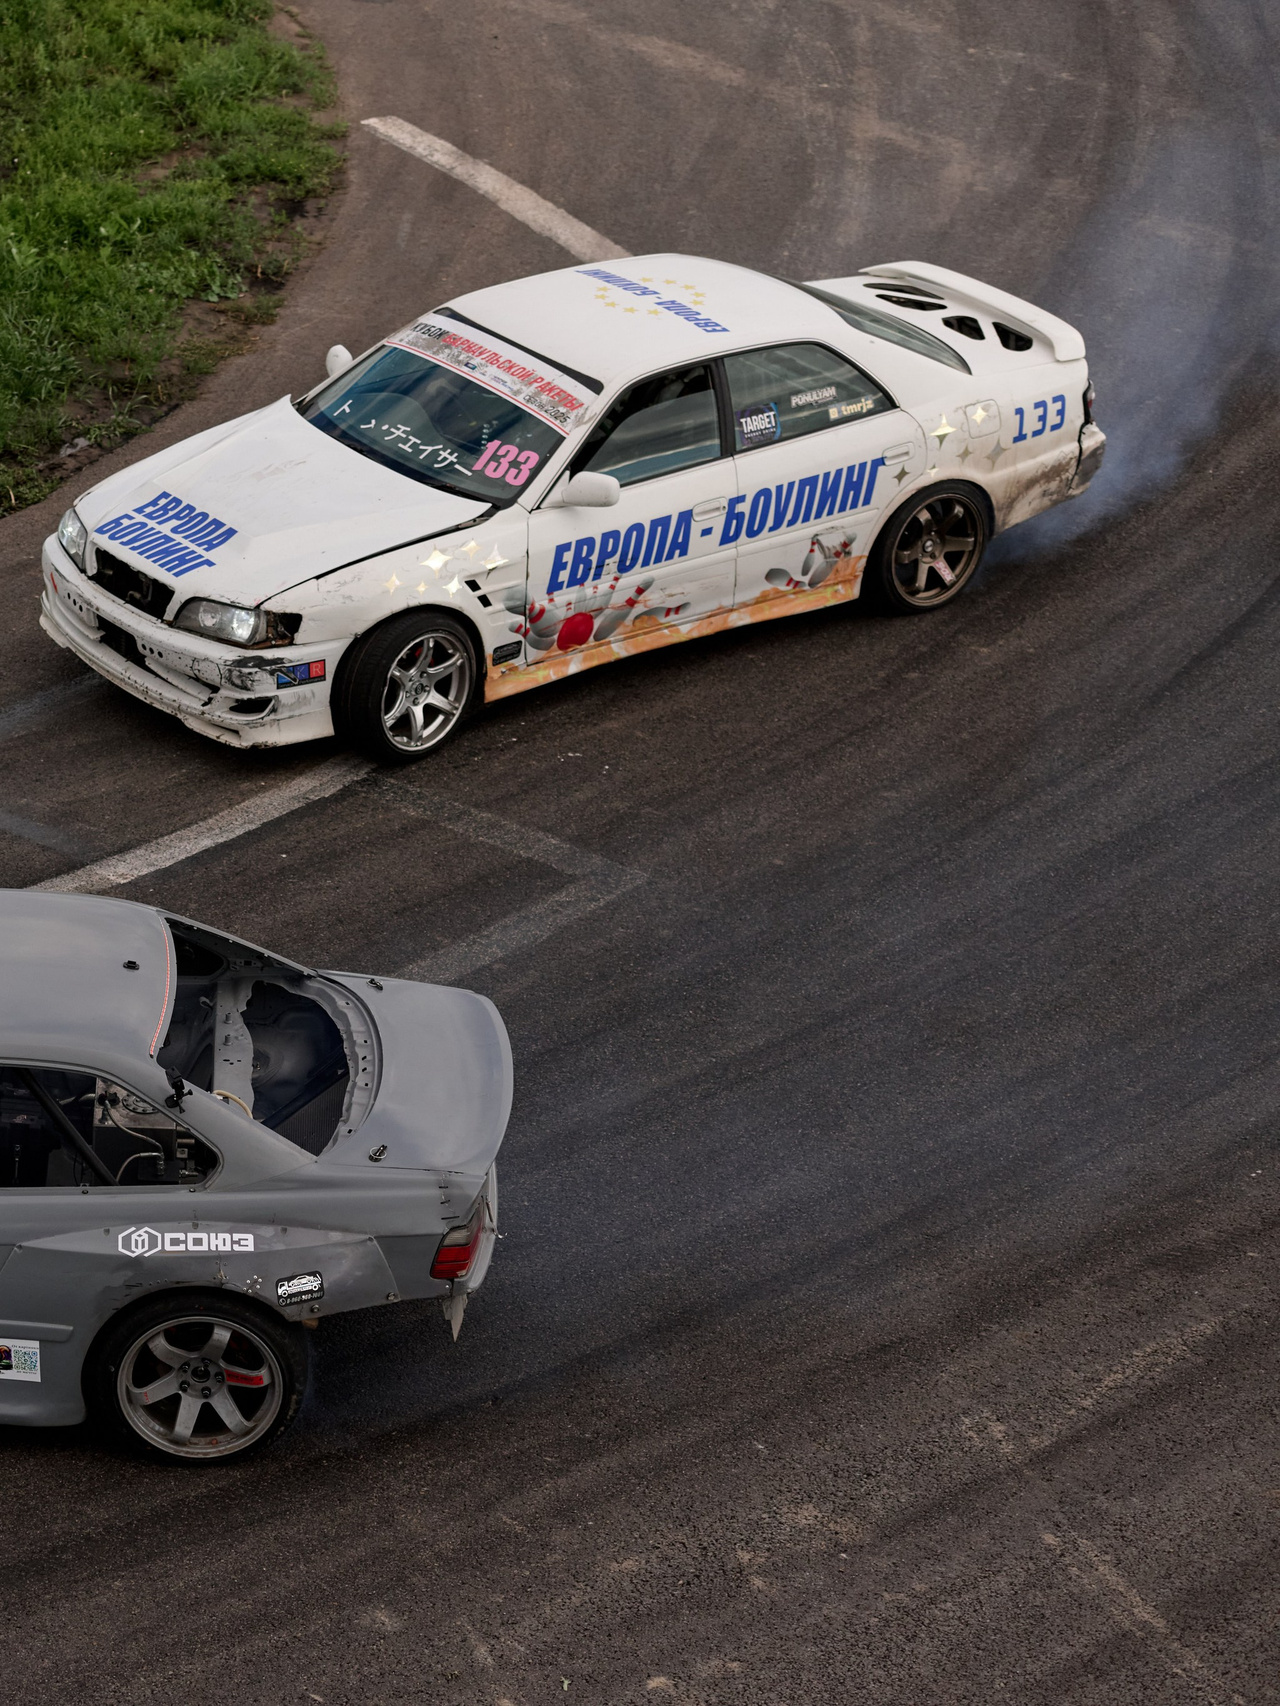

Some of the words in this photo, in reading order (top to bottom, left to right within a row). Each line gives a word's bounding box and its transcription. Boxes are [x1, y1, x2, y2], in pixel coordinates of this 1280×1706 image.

[574, 269, 661, 297] БОУЛИНГ
[654, 300, 731, 333] ЕВРОПА
[410, 322, 449, 340] КУБОК
[442, 333, 536, 382] БАРНАУЛЬСКОЙ
[528, 376, 585, 412] РАКЕТЫ
[545, 405, 571, 424] 2025
[740, 411, 777, 434] TARGET
[1012, 394, 1066, 444] 133
[472, 439, 540, 487] 133
[94, 513, 217, 578] БОУЛИНГ
[132, 491, 239, 552] ЕВРОПА
[546, 509, 694, 594] ЕВРОПА
[718, 456, 887, 547] БОУЛИНГ
[164, 1232, 254, 1251] СОЮЗ
